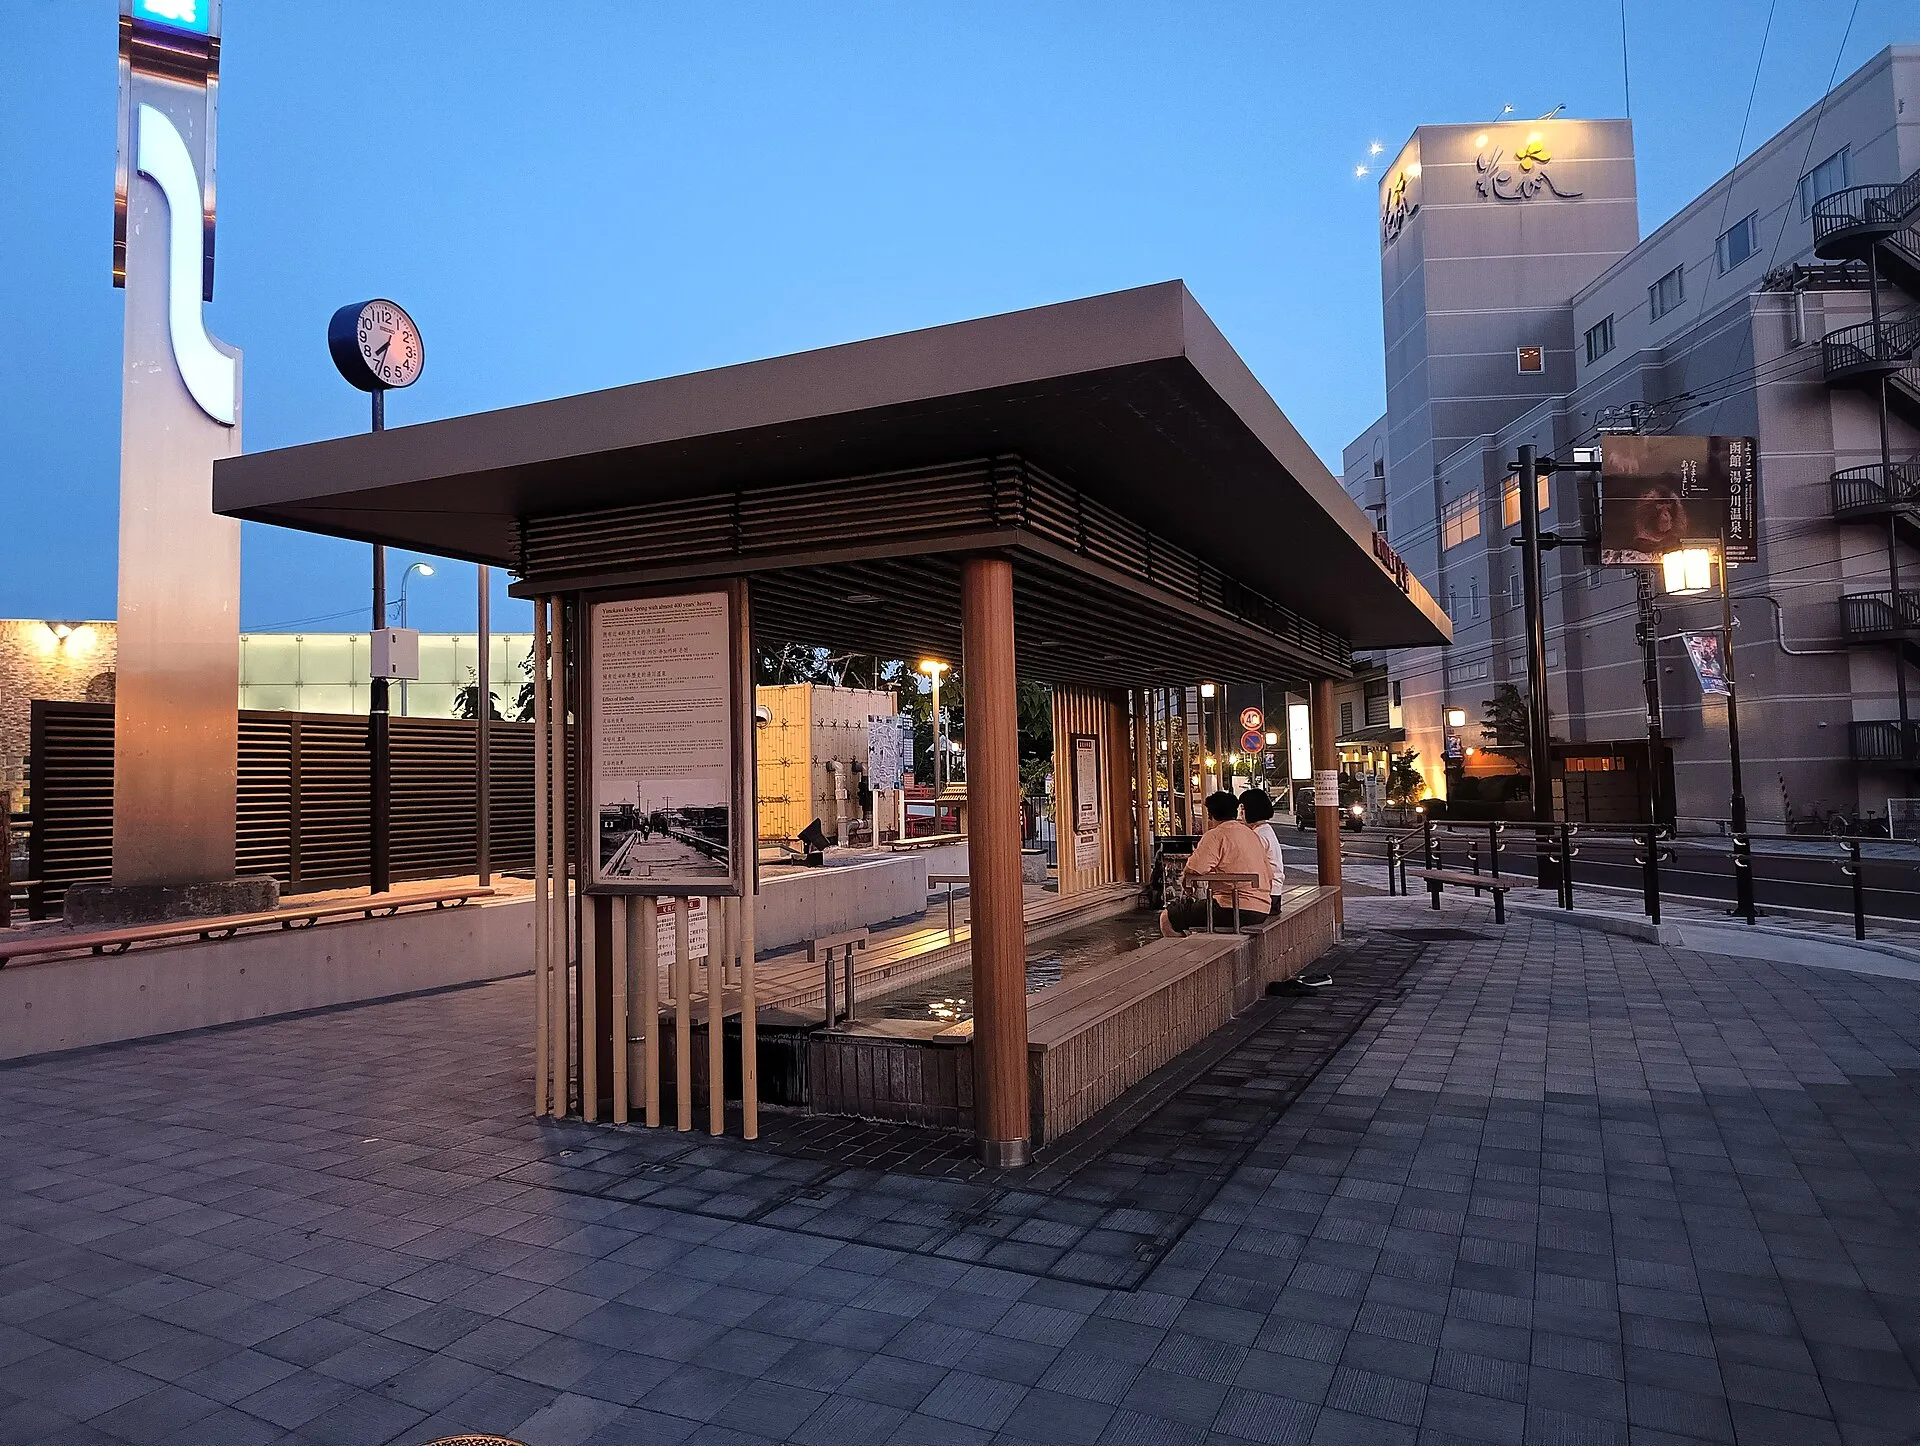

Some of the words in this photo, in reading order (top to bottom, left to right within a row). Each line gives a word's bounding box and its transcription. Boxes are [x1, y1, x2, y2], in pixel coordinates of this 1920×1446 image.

[372, 310, 380, 323] 11
[382, 310, 393, 325] 12
[361, 317, 373, 330] 10
[359, 330, 367, 343] 9
[402, 331, 409, 343] 2
[364, 345, 371, 357] 8
[405, 346, 413, 359] 3
[373, 358, 380, 370] 7
[402, 359, 410, 371] 4
[383, 365, 391, 379] 6
[394, 365, 402, 379] 5
[1744, 441, 1753, 482] ようこそ
[1729, 470, 1742, 540] 湯の川温泉へ
